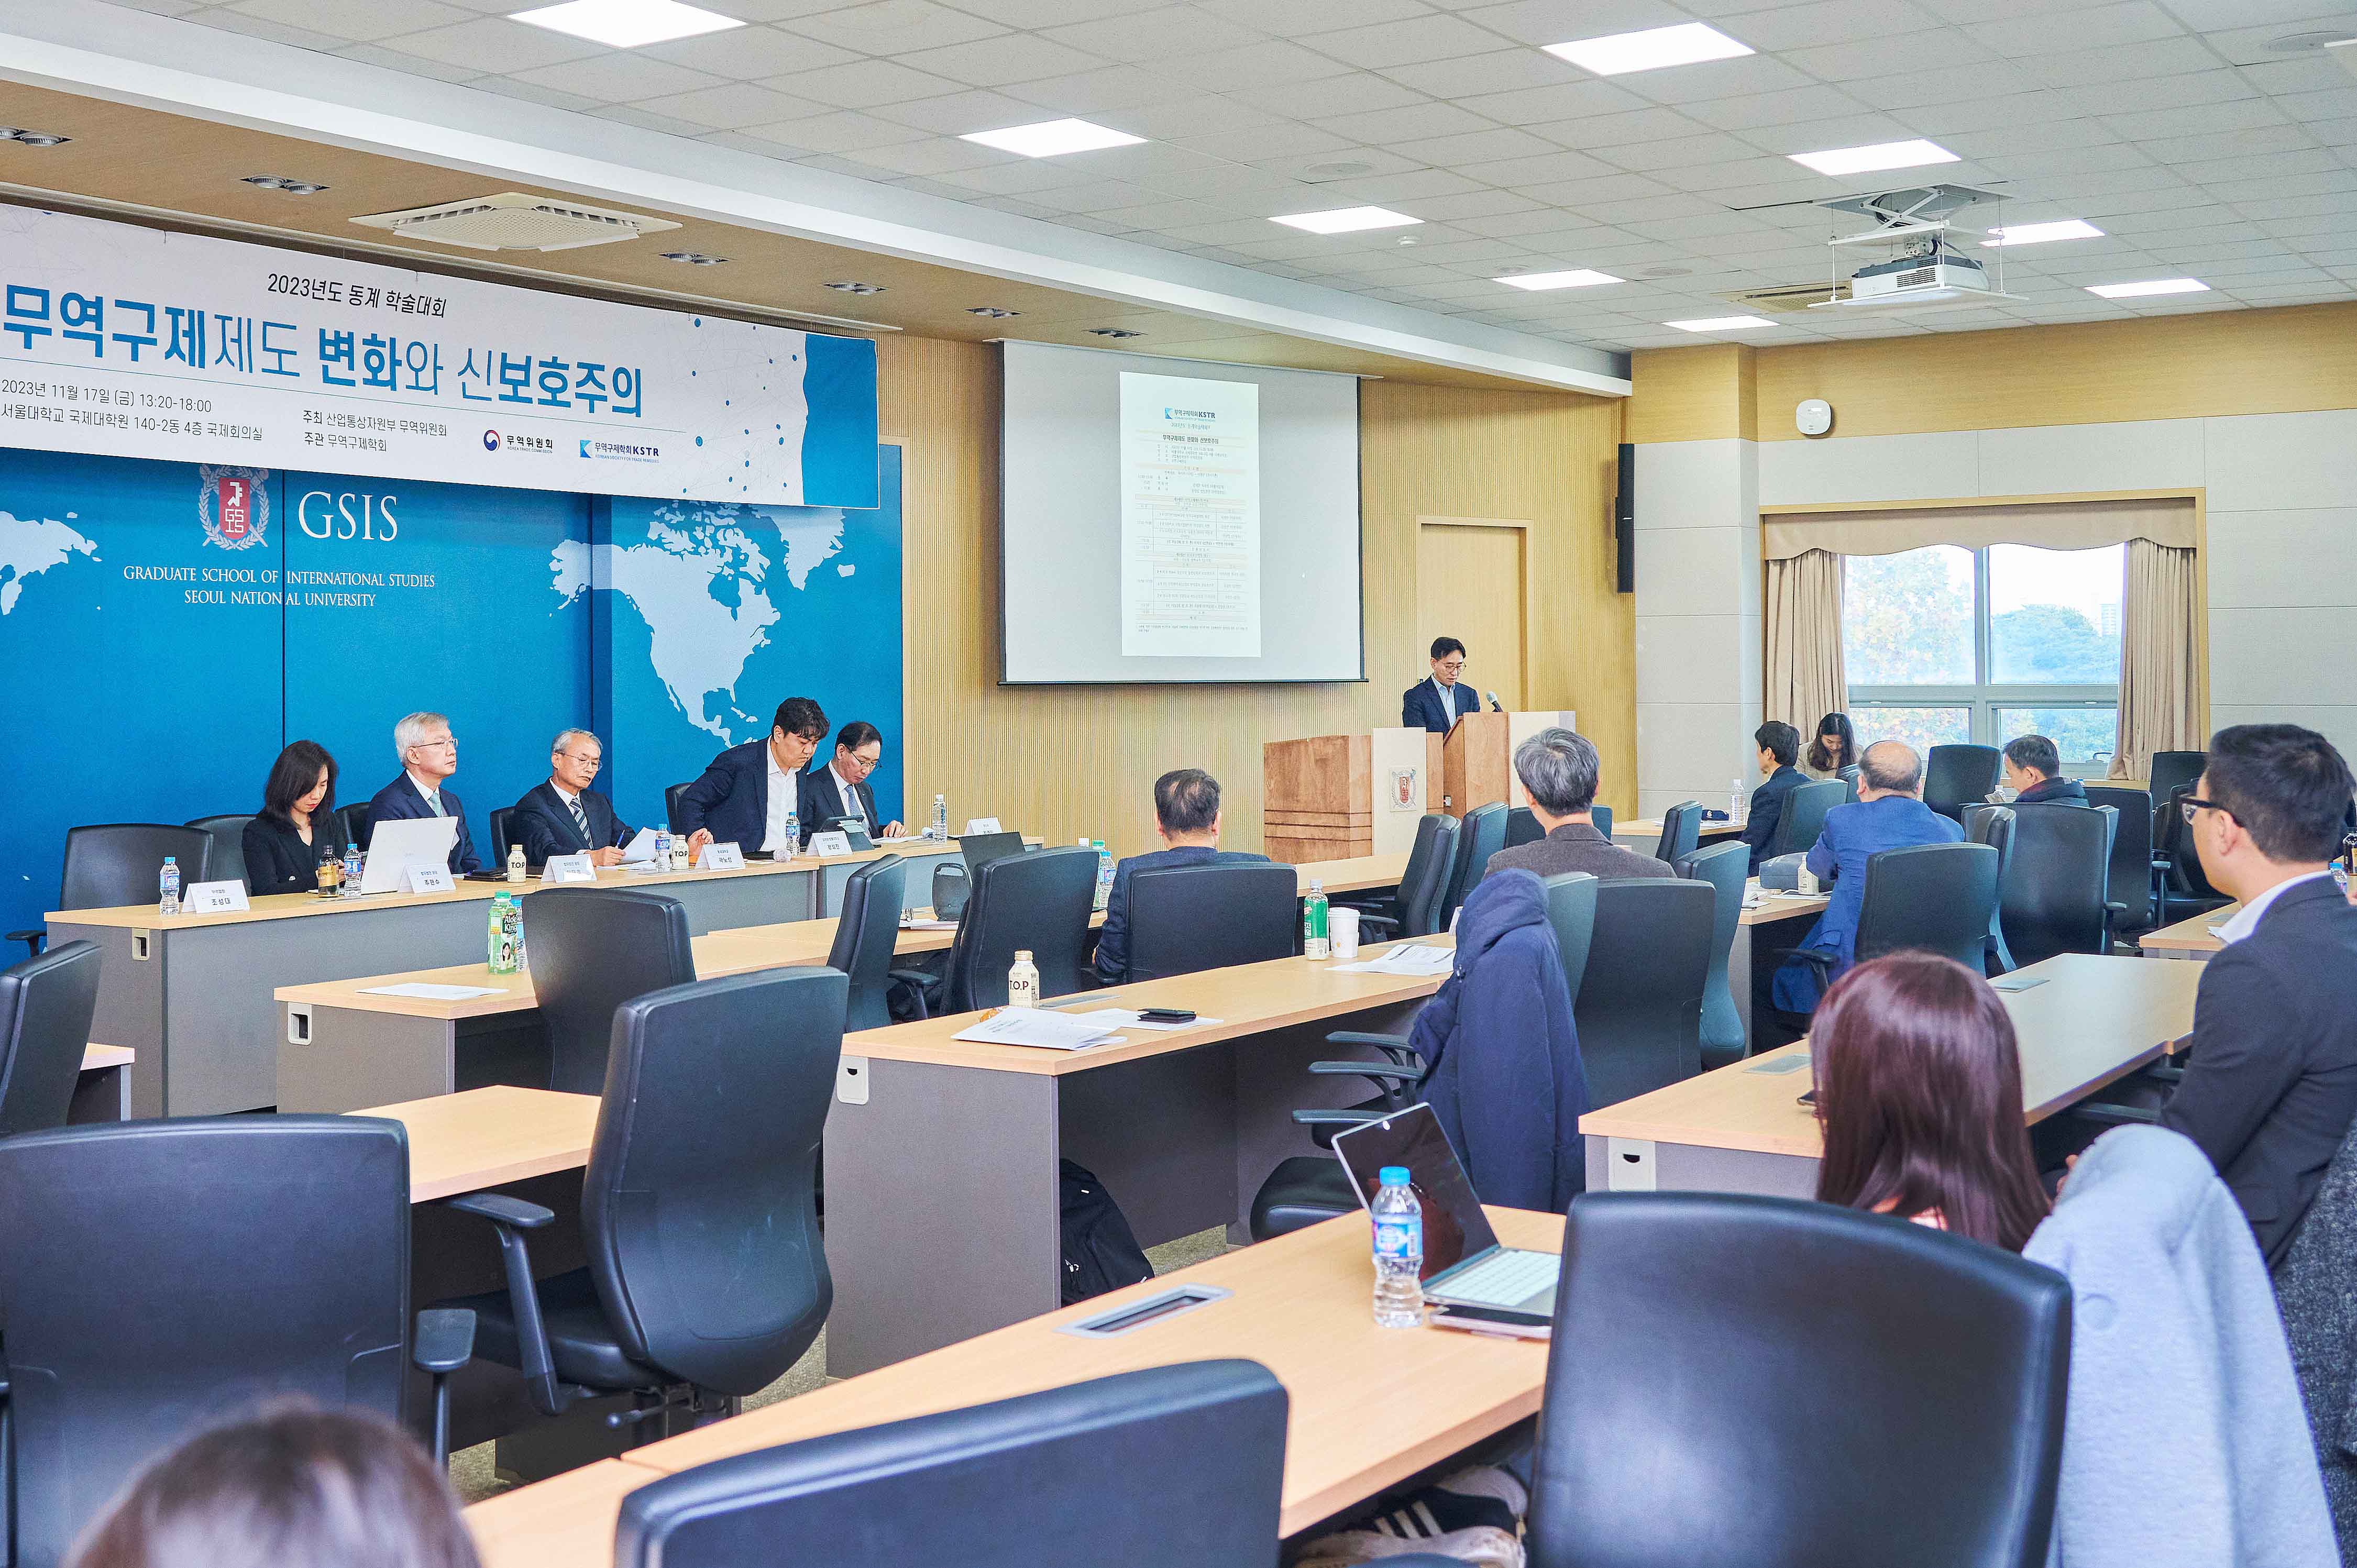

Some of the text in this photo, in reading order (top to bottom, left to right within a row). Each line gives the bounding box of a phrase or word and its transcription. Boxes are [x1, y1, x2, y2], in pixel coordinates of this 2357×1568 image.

[268, 273, 447, 318] 2023년도 동계 학술대회
[3, 284, 642, 418] 무역구제제도 변화와 신보호주의
[2, 380, 211, 412] 2023년 11월 17일 (금) 13:20-18:00
[1, 403, 262, 440] 서울대학교 국제대학원 140-2동 4층 국제회의실
[303, 411, 447, 436] 주최 산업통상자원부 무역위원회
[304, 432, 387, 452] 주관 무역구제학회
[507, 436, 553, 449] 무역위원회
[633, 445, 659, 457] KSTR
[299, 491, 398, 541] GSIS
[124, 566, 435, 587] GRADUATE SCHOOL OF INTERNATIONAL STUDIES
[184, 590, 376, 606] SEOUL NATIONAL UNIVERSITY
[504, 915, 517, 923] Aloe
[504, 923, 517, 932] King
[1009, 980, 1029, 990] T.O.P
